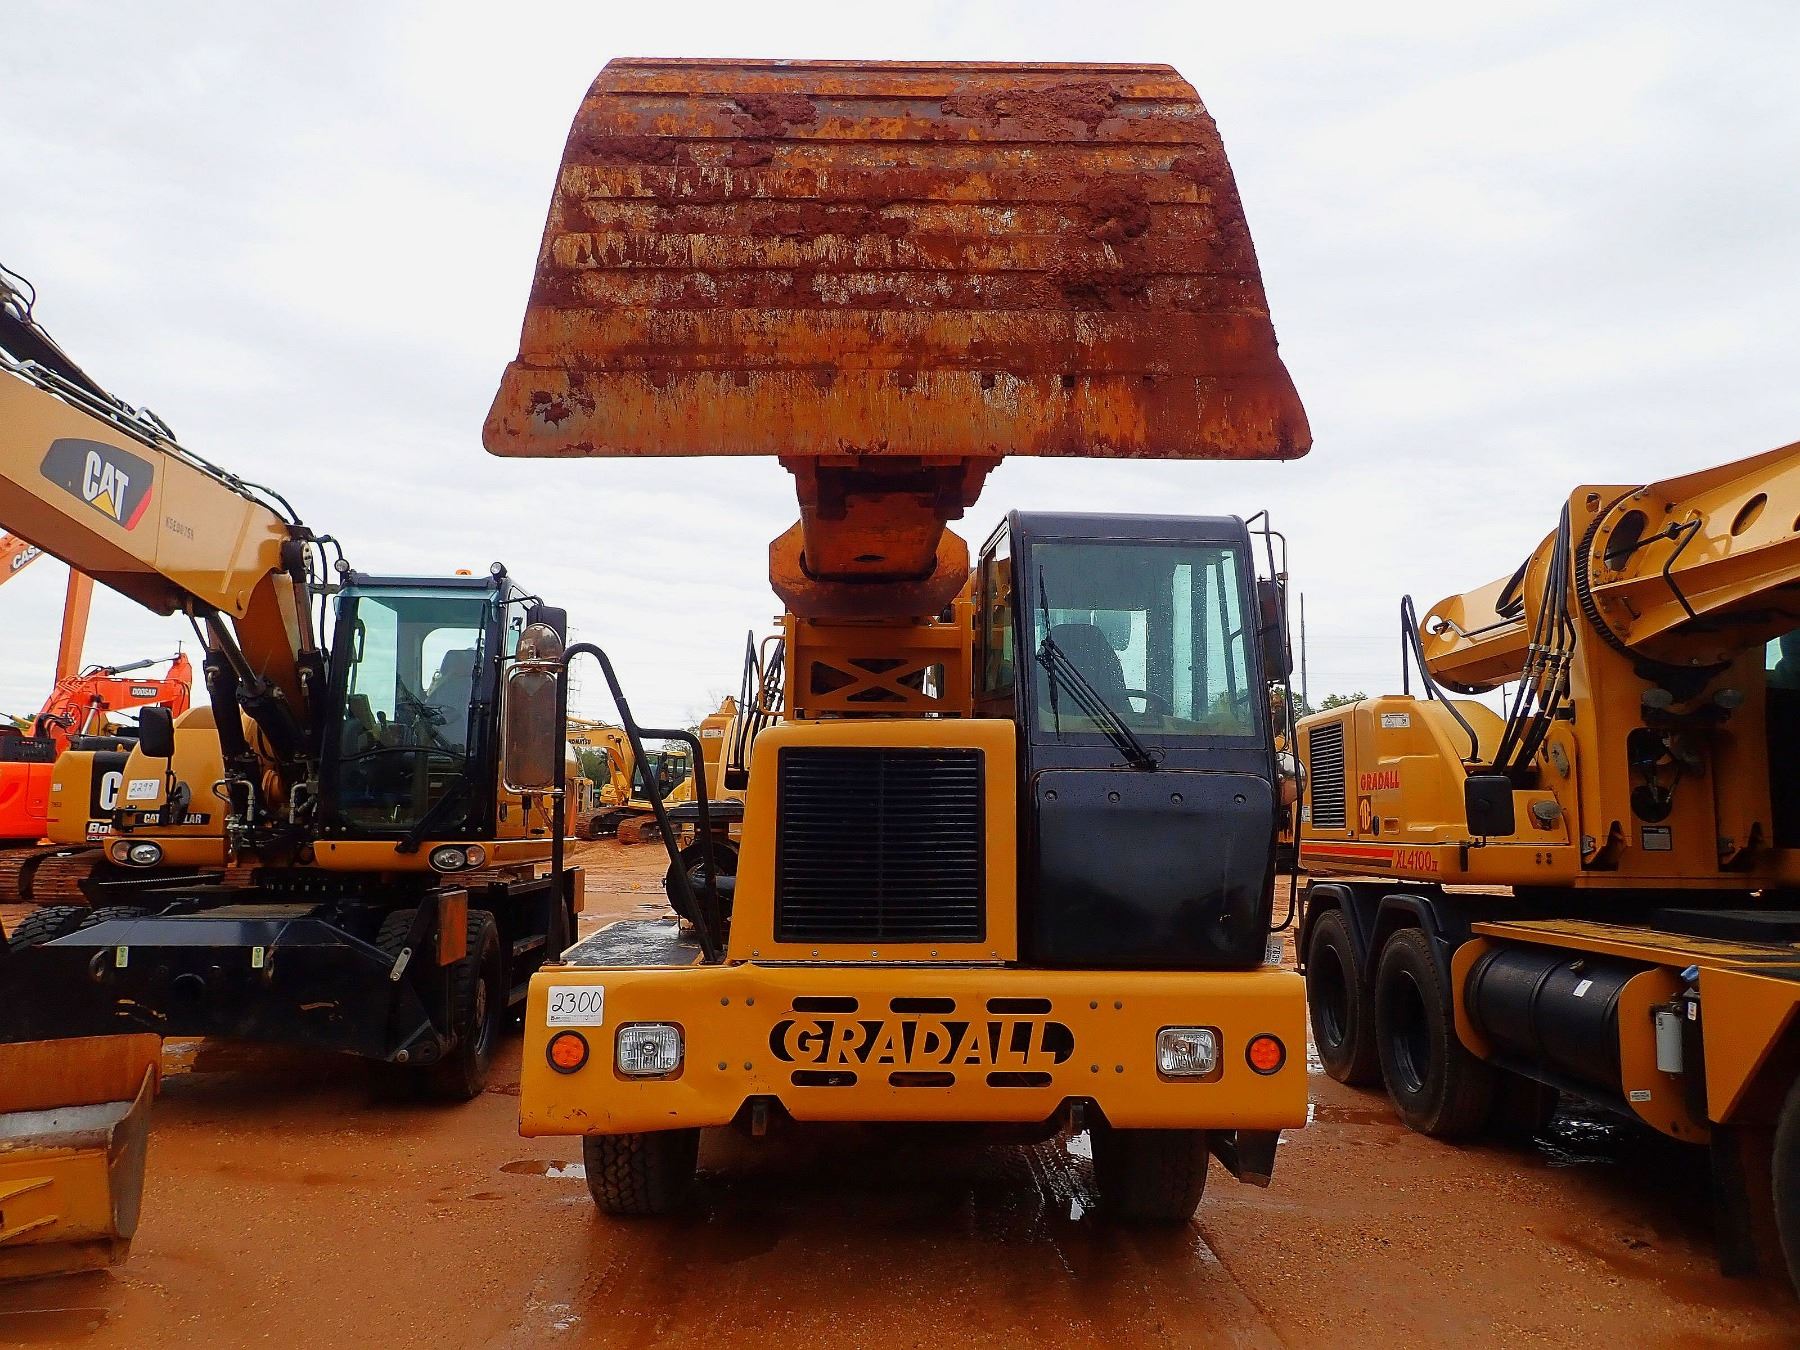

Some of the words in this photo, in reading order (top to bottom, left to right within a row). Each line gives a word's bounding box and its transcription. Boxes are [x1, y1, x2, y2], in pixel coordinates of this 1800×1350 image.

[82, 450, 129, 521] CAT
[12, 545, 42, 569] CAS
[1360, 770, 1400, 791] GRADALL
[551, 991, 603, 1014] 2300
[784, 1019, 1056, 1064] GRADALL
